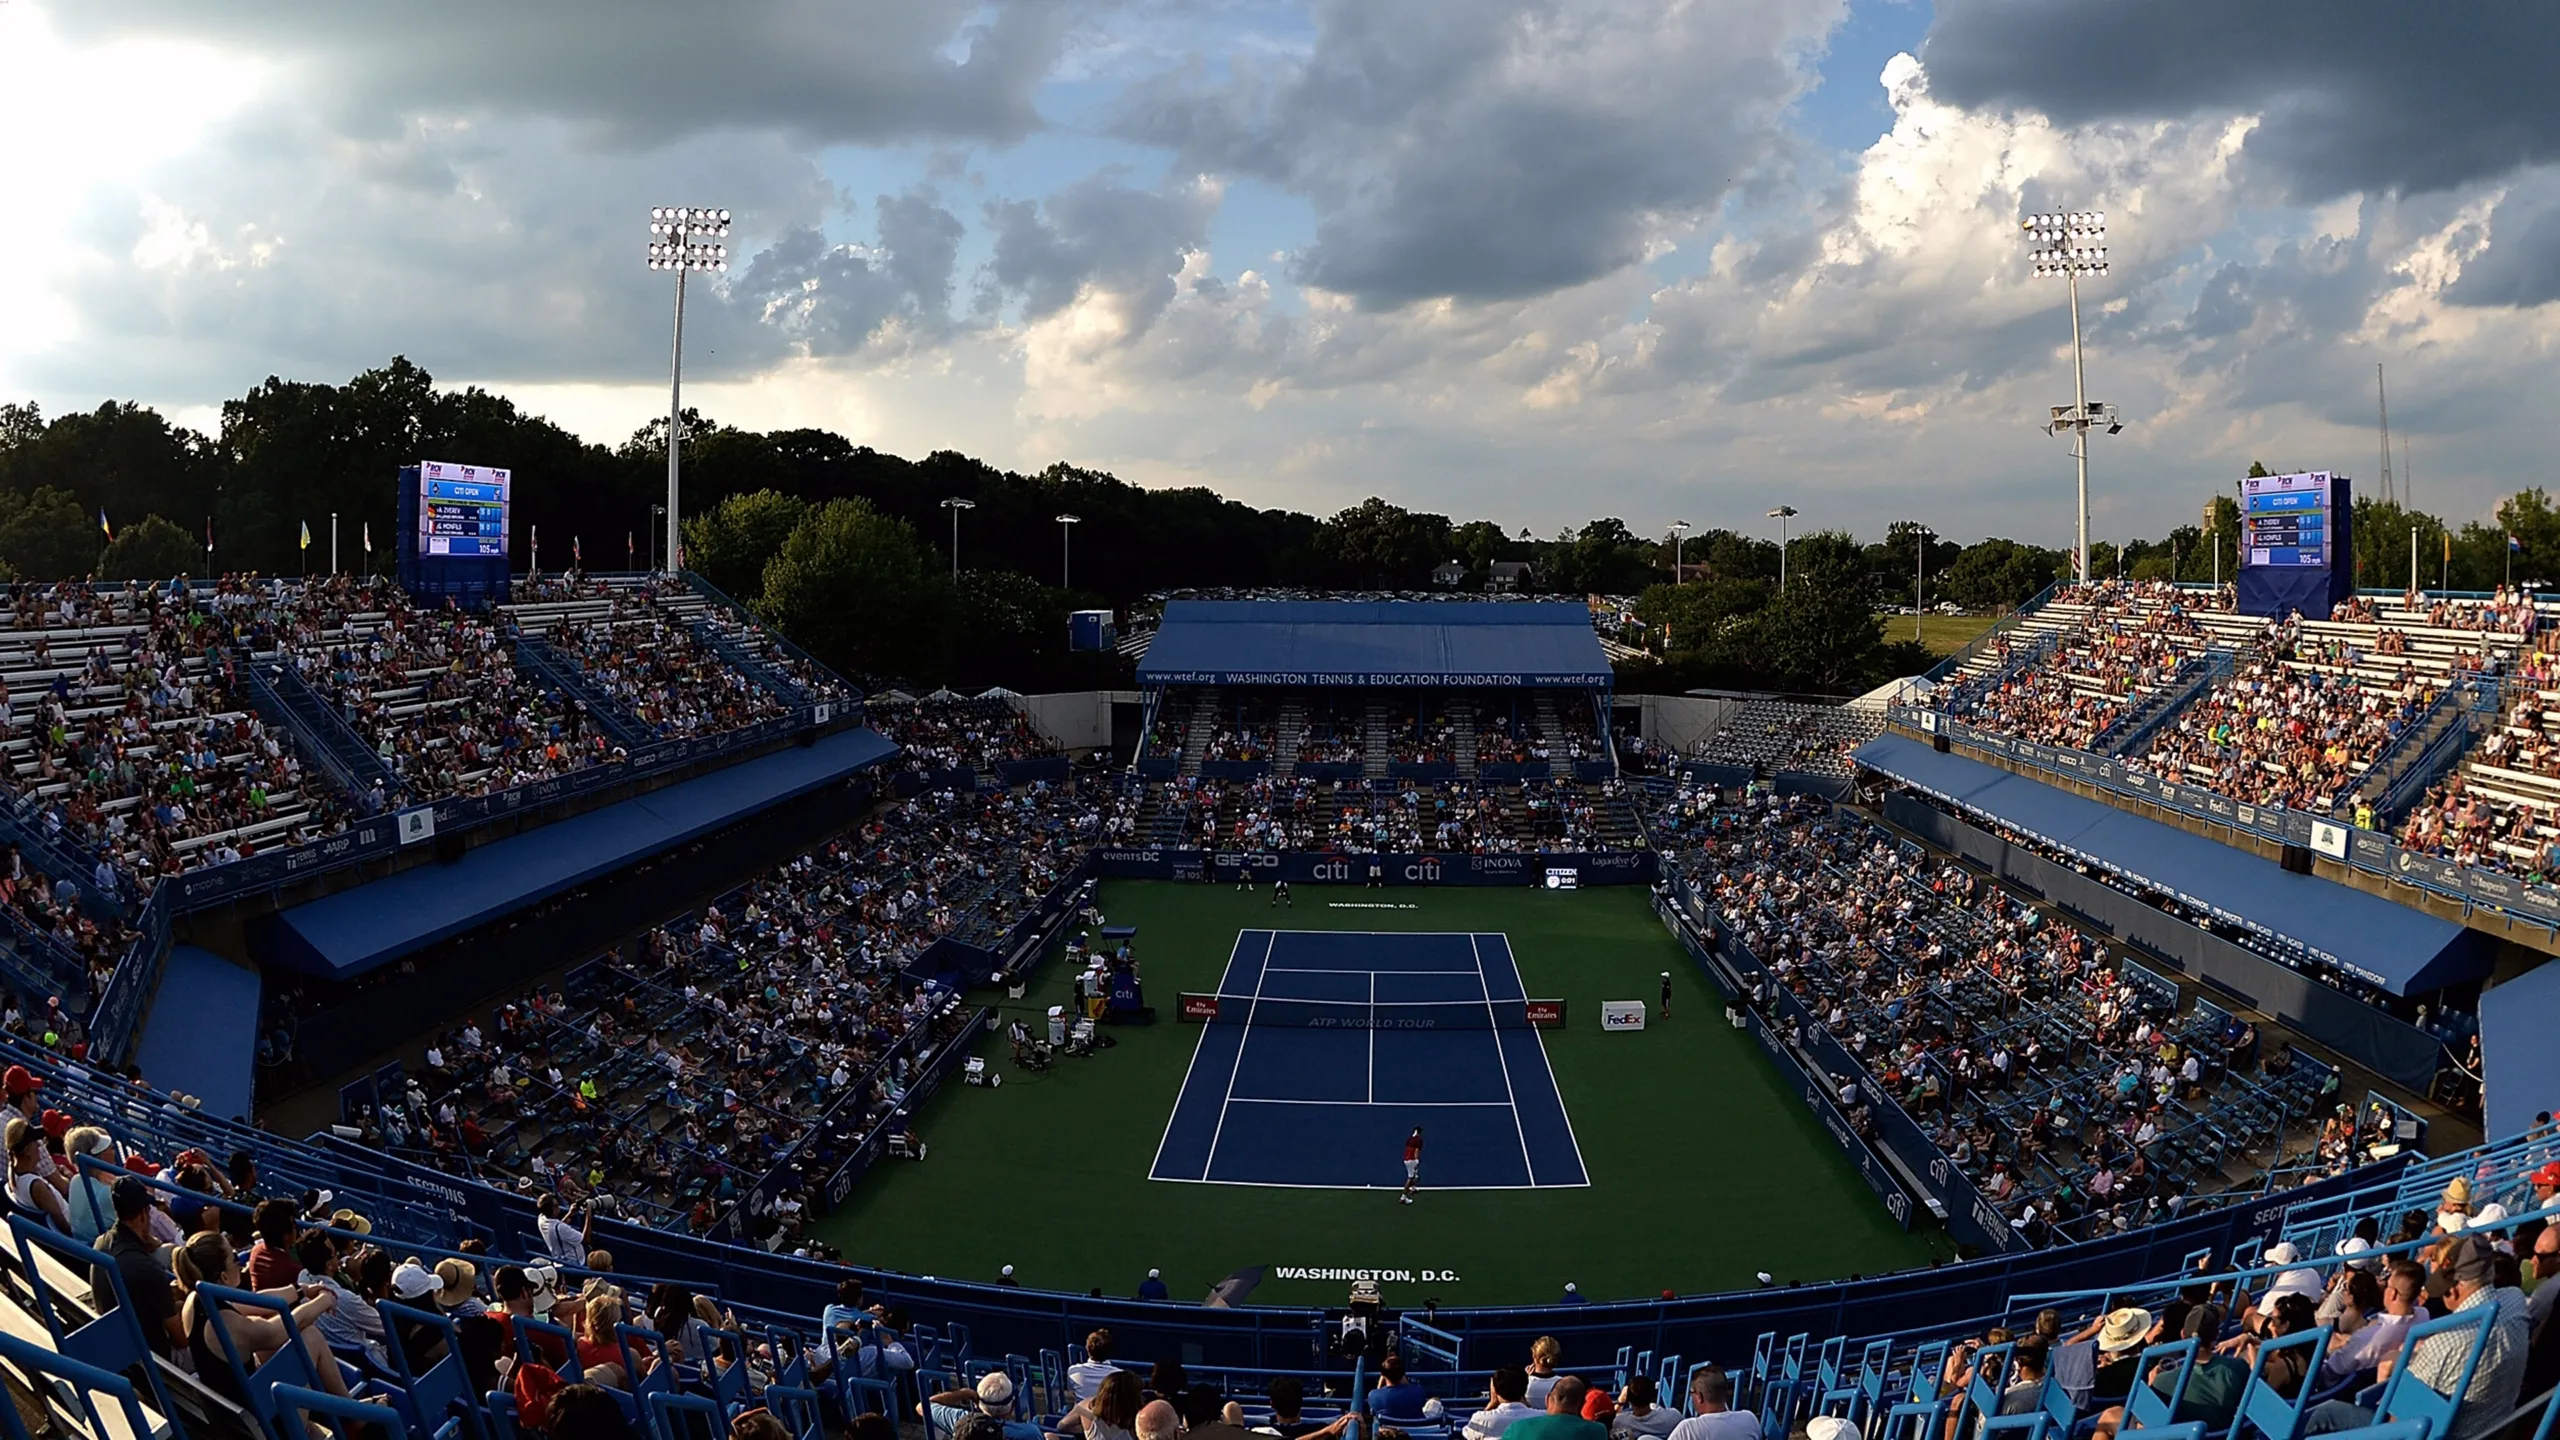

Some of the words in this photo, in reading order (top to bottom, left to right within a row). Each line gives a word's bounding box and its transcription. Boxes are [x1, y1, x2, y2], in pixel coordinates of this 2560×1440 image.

[1146, 672, 1216, 684] www.wtef.org
[1226, 673, 1308, 685] WASHINGTON
[1312, 674, 1354, 685] TENNIS
[1358, 674, 1366, 685] &
[1370, 674, 1440, 686] EDUCATION
[1443, 674, 1522, 686] FOUNDATION
[1535, 673, 1605, 686] www.wtef.org
[633, 754, 656, 767] GEICO
[2059, 754, 2077, 766] GEICO
[326, 838, 350, 855] AARP
[296, 848, 317, 863] TENNIS
[1102, 850, 1160, 863] eventsDC
[1215, 854, 1279, 868] GECO
[1483, 857, 1522, 869] INOVA
[2411, 861, 2430, 873] pepsi
[1313, 861, 1349, 880] citi
[1404, 861, 1441, 881] citi
[1545, 868, 1578, 876] CITIZEN
[2435, 872, 2462, 888] LACOSTE
[2355, 966, 2387, 985] MANSDORF
[1115, 989, 1133, 1000] citi
[1185, 1006, 1216, 1015] Emirates
[1527, 1011, 1557, 1020] Emirates
[1309, 1017, 1336, 1027] ATP
[1397, 1019, 1435, 1029] TOUR
[1607, 1014, 1641, 1026] FedEx
[1807, 1022, 1821, 1045] citi
[1861, 1075, 1883, 1106] GEICO
[1929, 1158, 1949, 1188] citi
[833, 1169, 852, 1205] citi
[1887, 1192, 1906, 1222] citi
[1984, 1207, 2010, 1243] TENNIS
[1275, 1267, 1416, 1284] WASHINGTON,
[1421, 1270, 1461, 1282] D.C.
